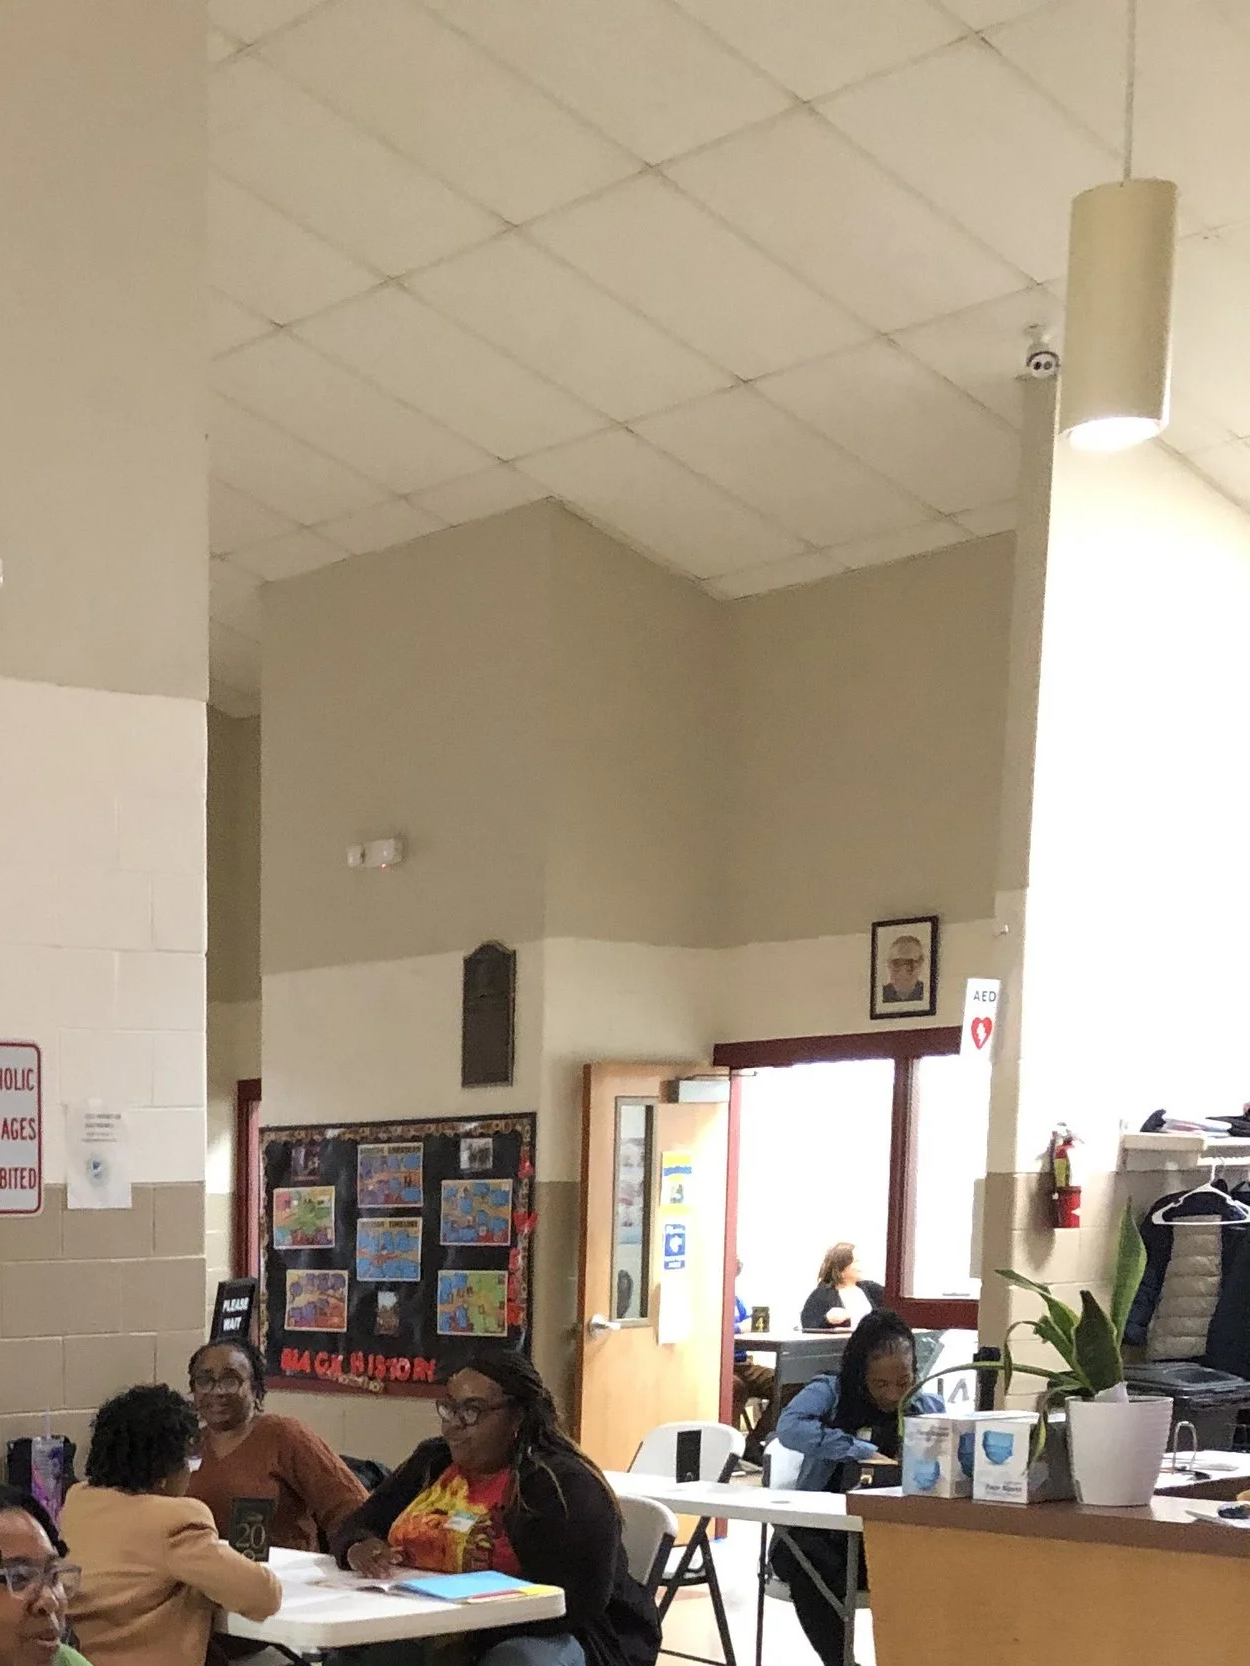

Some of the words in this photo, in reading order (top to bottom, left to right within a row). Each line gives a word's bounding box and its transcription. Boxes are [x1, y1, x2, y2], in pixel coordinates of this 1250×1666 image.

[973, 990, 997, 1002] AED
[222, 1296, 250, 1313] PLEASE
[223, 1316, 242, 1331] WAIT
[755, 1315, 765, 1332] 4
[349, 1351, 437, 1382] HISTORY
[235, 1522, 266, 1549] 20
